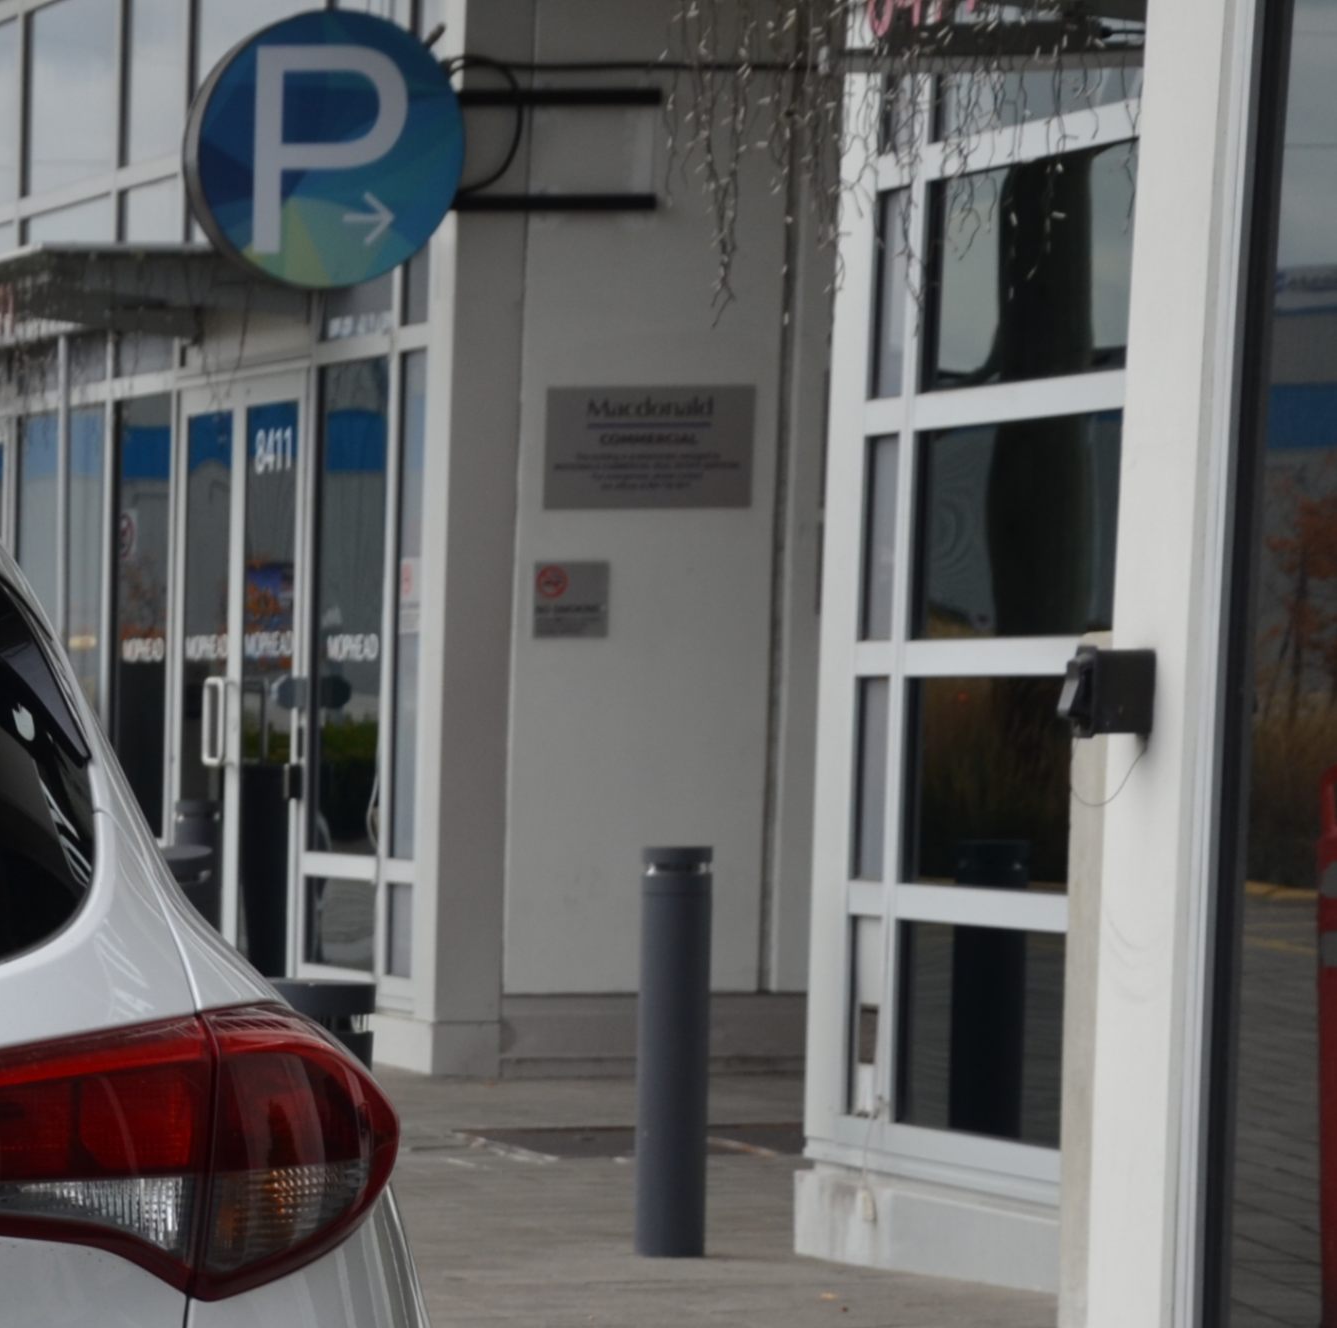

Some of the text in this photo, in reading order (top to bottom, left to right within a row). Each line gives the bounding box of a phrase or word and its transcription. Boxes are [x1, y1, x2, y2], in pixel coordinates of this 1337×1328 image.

[251, 44, 409, 255] P
[587, 395, 714, 418] Macdonald
[255, 426, 293, 474] 8411
